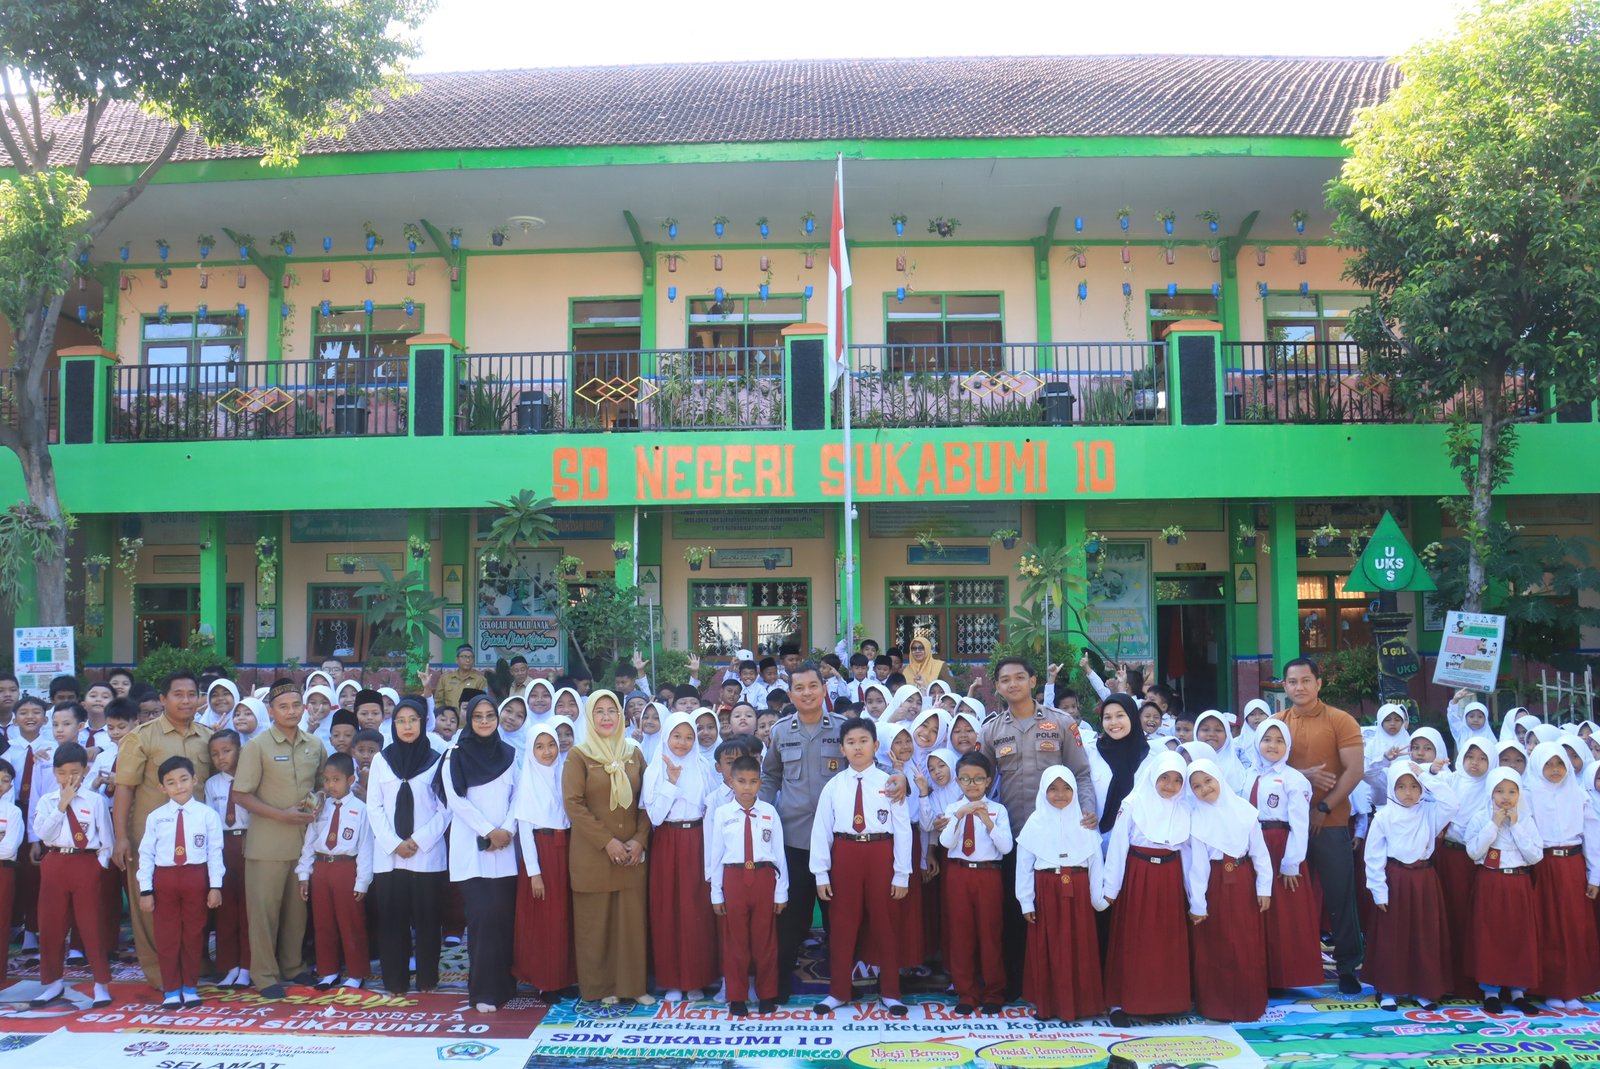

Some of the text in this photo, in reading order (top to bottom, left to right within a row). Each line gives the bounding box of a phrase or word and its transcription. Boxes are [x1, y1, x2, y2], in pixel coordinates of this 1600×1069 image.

[551, 439, 1116, 501] SD NEGERI SUKABUMI 10
[1374, 558, 1404, 569] UKS
[479, 620, 508, 630] SEKOLAH
[509, 620, 532, 630] RAMAH
[1396, 663, 1418, 675] UKS
[1036, 732, 1060, 740] POLRI
[76, 1013, 492, 1034] SD NEGERI SUKABUMI 10
[573, 1019, 720, 1032] Meningkatkan
[729, 1022, 839, 1032] Keimanan
[842, 1023, 880, 1032] dan
[884, 1022, 999, 1034] Ketaqwaan
[1005, 1020, 1084, 1032] Kepada
[1090, 1018, 1142, 1028] Alh
[550, 1033, 834, 1046] SDN SUKABUMI 10
[967, 1032, 1095, 1040] Agenda Kegiatan
[618, 1047, 694, 1058] MAYANGAN
[696, 1048, 738, 1059] KOTA
[738, 1049, 843, 1060] PROBOLINGGO
[989, 1046, 1097, 1056] Pondok Ramadhan
[1453, 1041, 1556, 1055] SDN
[155, 1060, 287, 1069] SELAMAT
